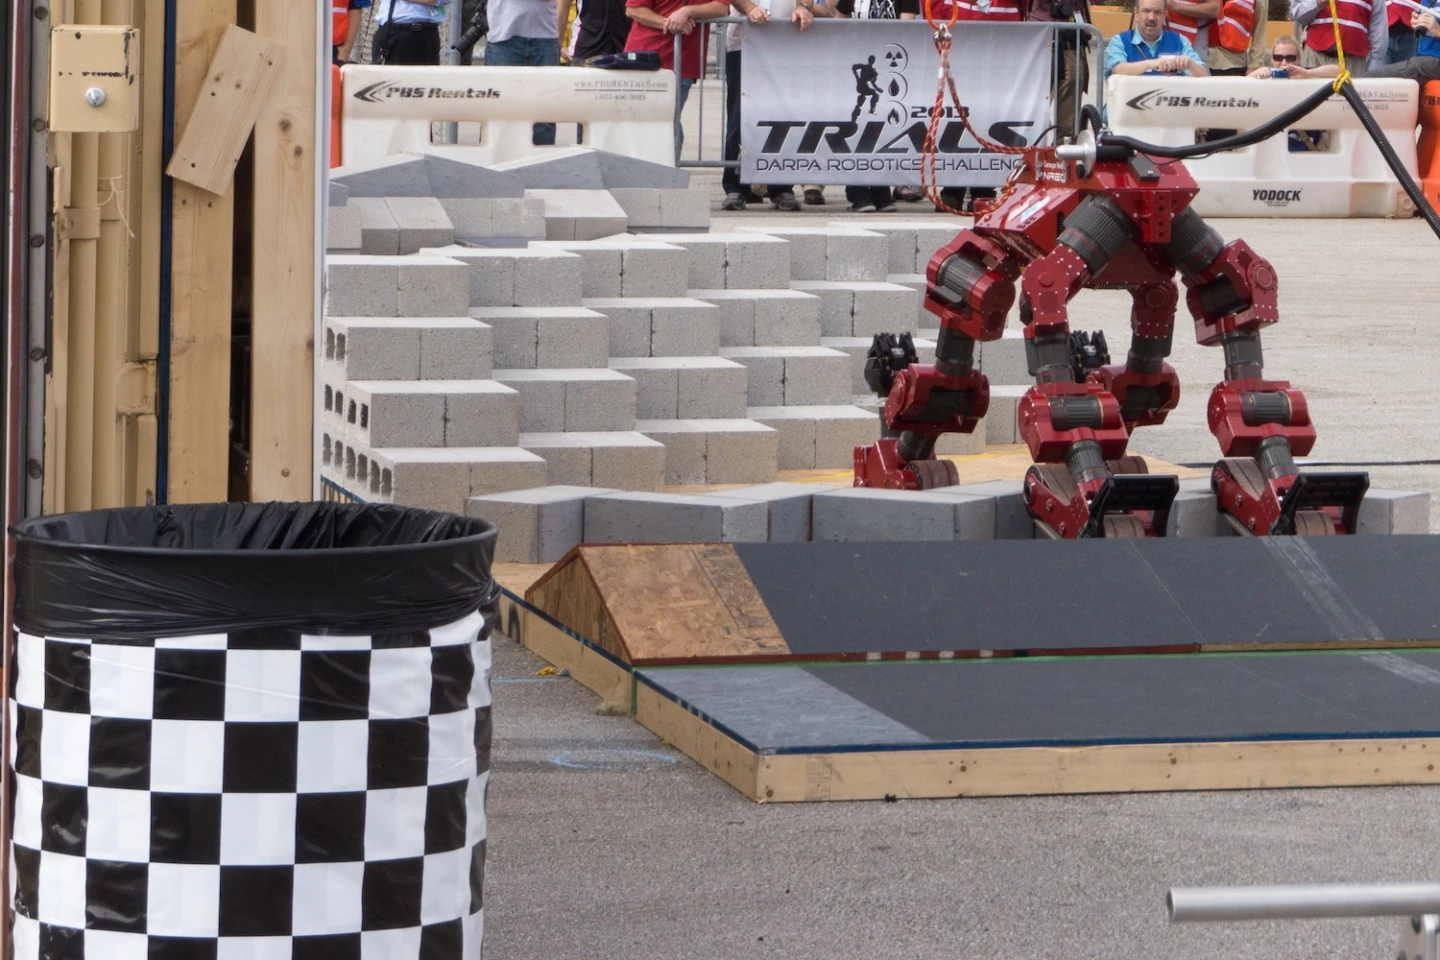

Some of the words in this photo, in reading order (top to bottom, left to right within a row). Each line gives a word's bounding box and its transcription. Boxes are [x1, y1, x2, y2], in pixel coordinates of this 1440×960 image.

[388, 87, 427, 98] PBS
[428, 87, 501, 99] Rentals
[1155, 96, 1191, 108] PBS
[1193, 97, 1260, 109] Rentals
[1423, 94, 1436, 106] PBS
[755, 120, 1035, 155] TRIALS
[756, 158, 822, 171] DARPA
[827, 158, 923, 171] ROBOTICS
[1252, 189, 1302, 201] YODOCK
